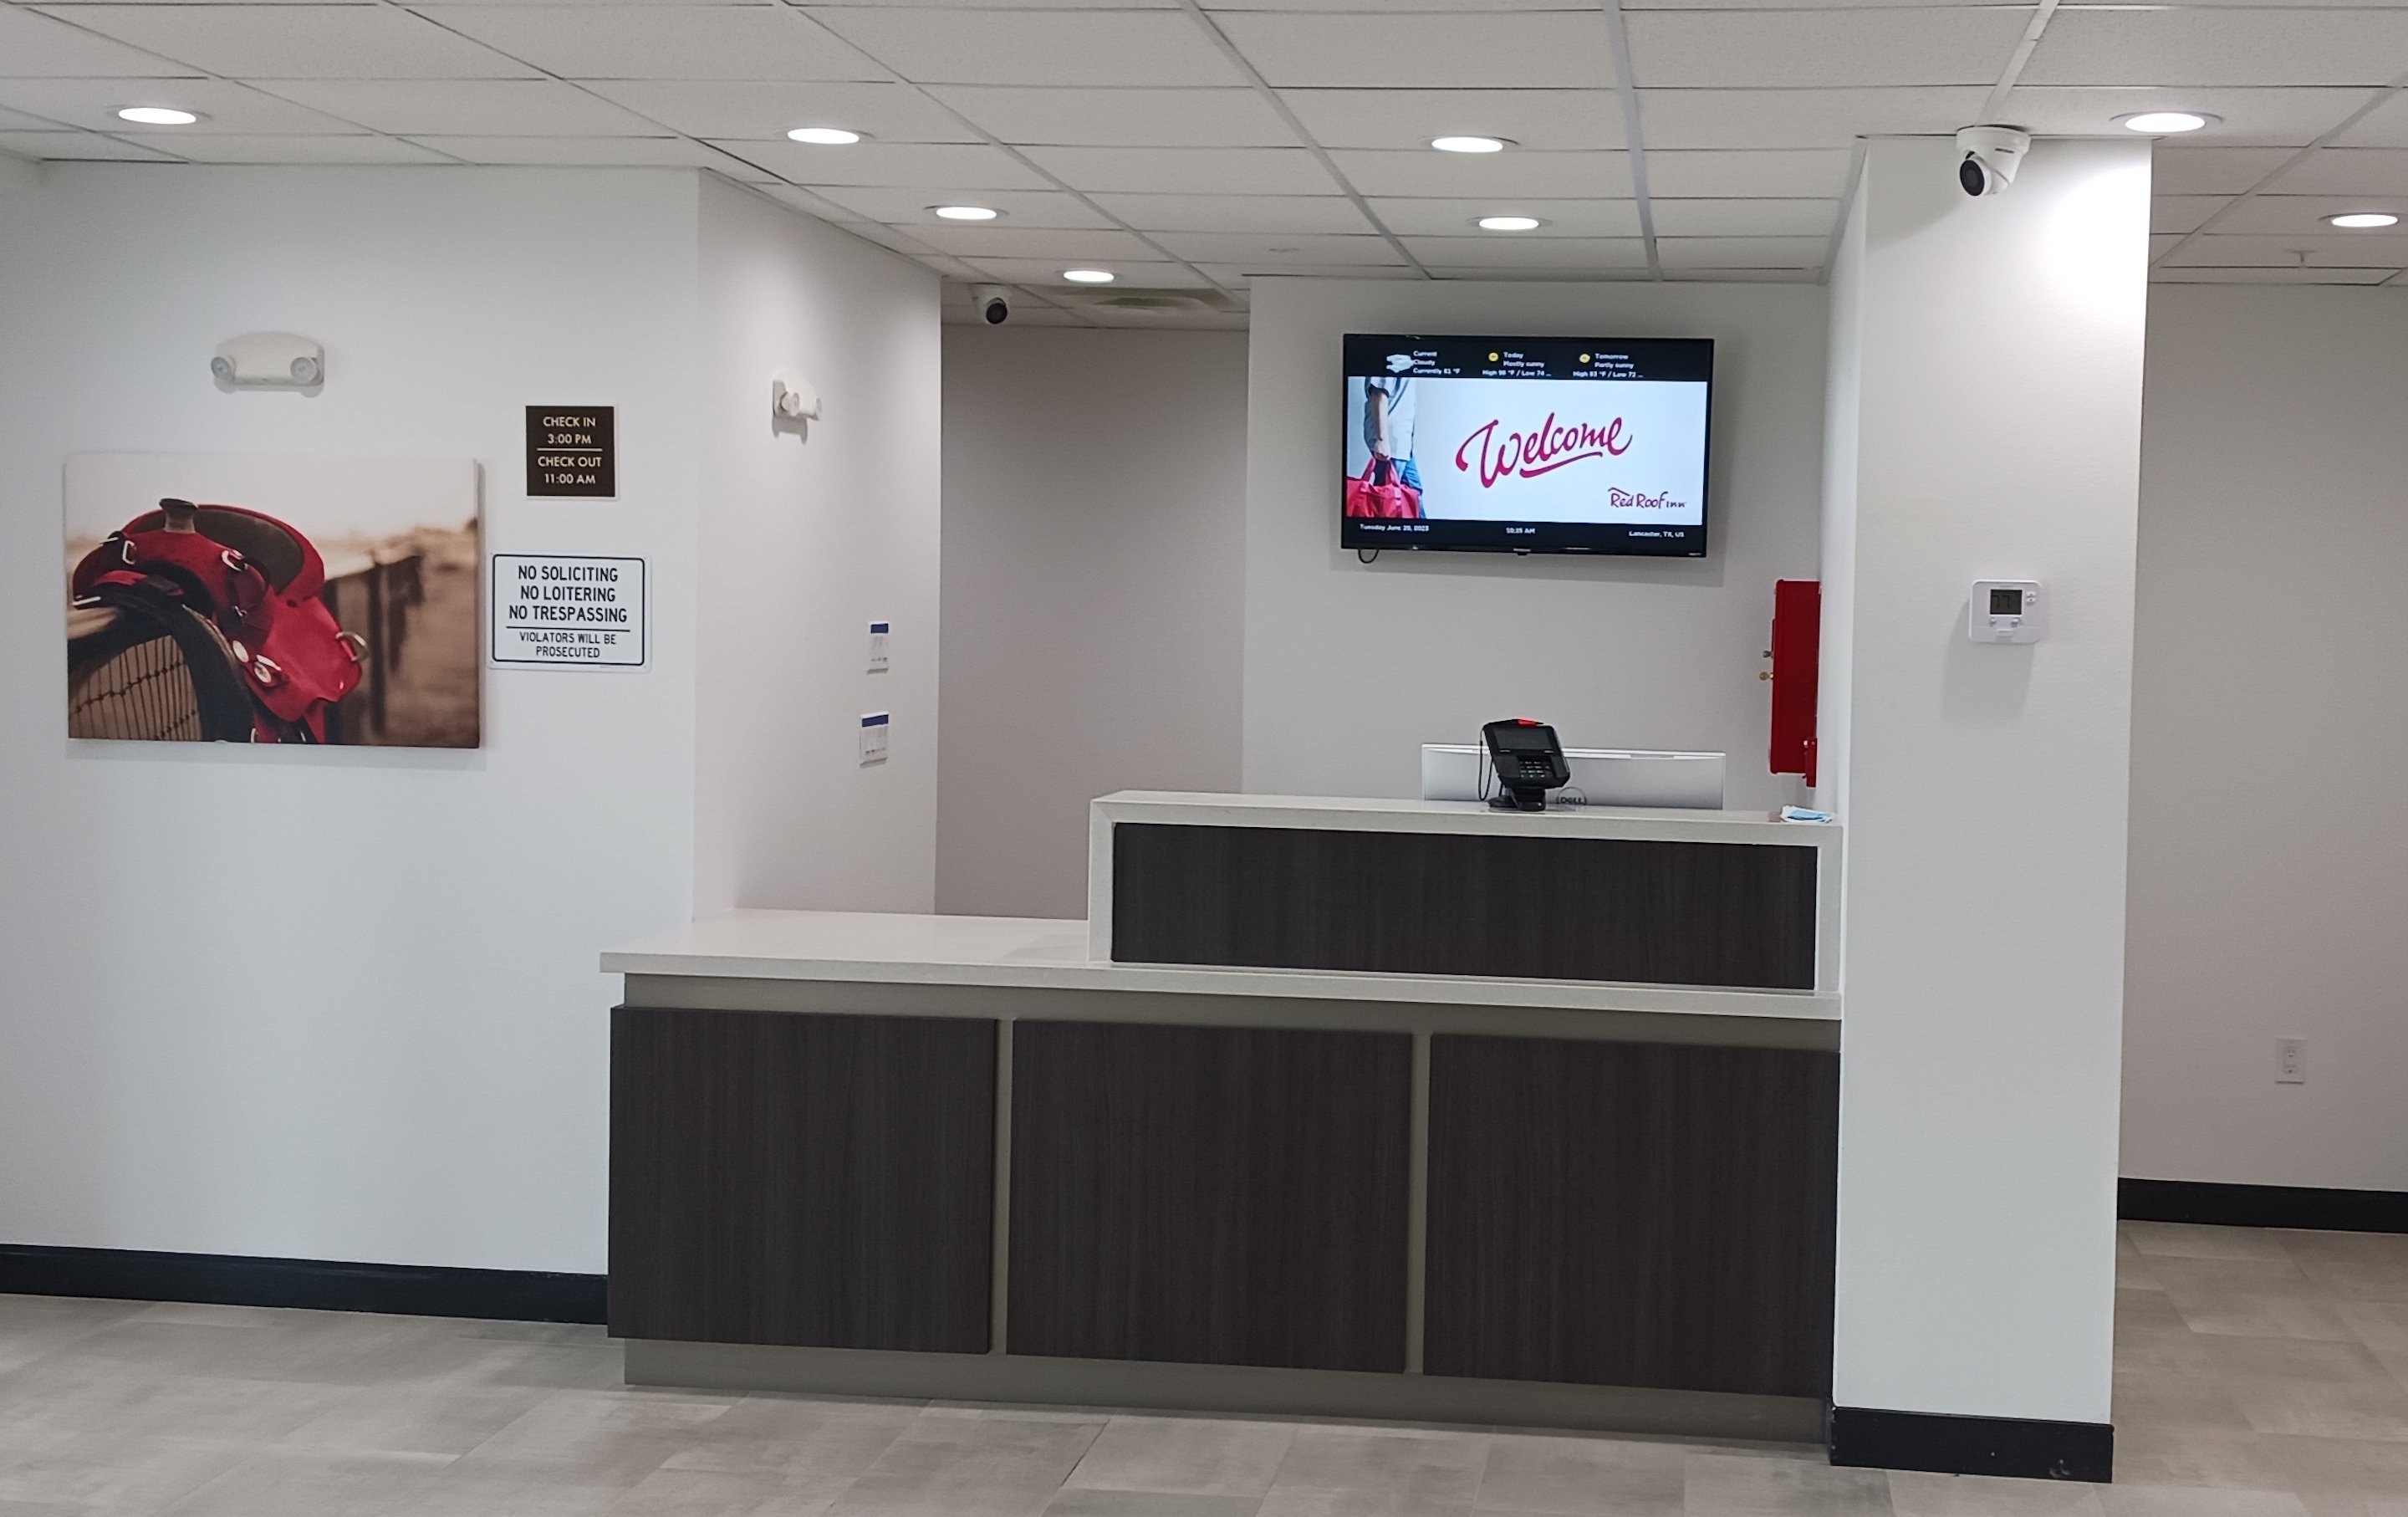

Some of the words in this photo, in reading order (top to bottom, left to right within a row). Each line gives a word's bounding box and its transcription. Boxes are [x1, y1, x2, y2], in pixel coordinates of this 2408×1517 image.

[1503, 351, 1524, 360] Today
[543, 416, 580, 427] CHECK
[583, 417, 596, 427] IN
[548, 433, 573, 444] 3:00
[574, 434, 592, 444] PM
[1455, 411, 1633, 488] Welcome
[538, 456, 575, 467] CHECK
[578, 457, 602, 467] OUT
[544, 473, 574, 484] 11:00
[576, 474, 596, 484] AM
[1610, 493, 1635, 508] Red
[1636, 491, 1669, 509] Roof
[518, 564, 537, 580] NO
[541, 565, 619, 582] SOLICITING
[520, 585, 539, 600] NO
[543, 585, 616, 602] LOITERING
[508, 605, 528, 620] NO
[532, 605, 627, 622] TRESPASSING
[519, 631, 575, 643] VIOLATORS
[578, 633, 600, 644] WILL
[603, 634, 617, 645] BE
[535, 646, 601, 658] PROSECUTED
[1560, 796, 1584, 805] DELL
